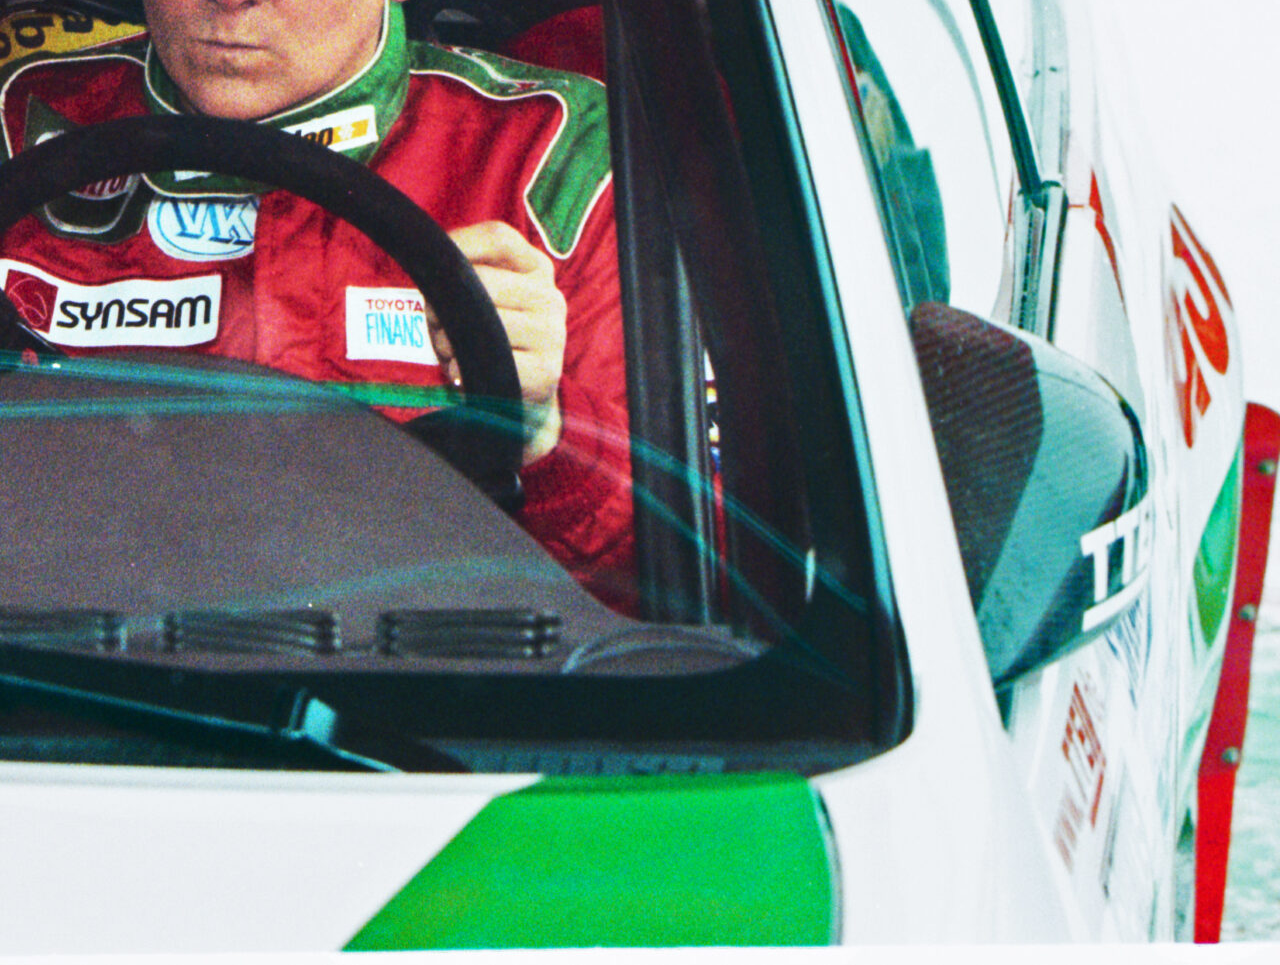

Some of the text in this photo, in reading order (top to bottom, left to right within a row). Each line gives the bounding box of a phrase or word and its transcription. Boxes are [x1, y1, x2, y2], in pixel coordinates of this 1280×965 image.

[56, 294, 212, 331] SYNSAM
[365, 299, 424, 313] TOYOTA
[365, 313, 424, 349] FINANS
